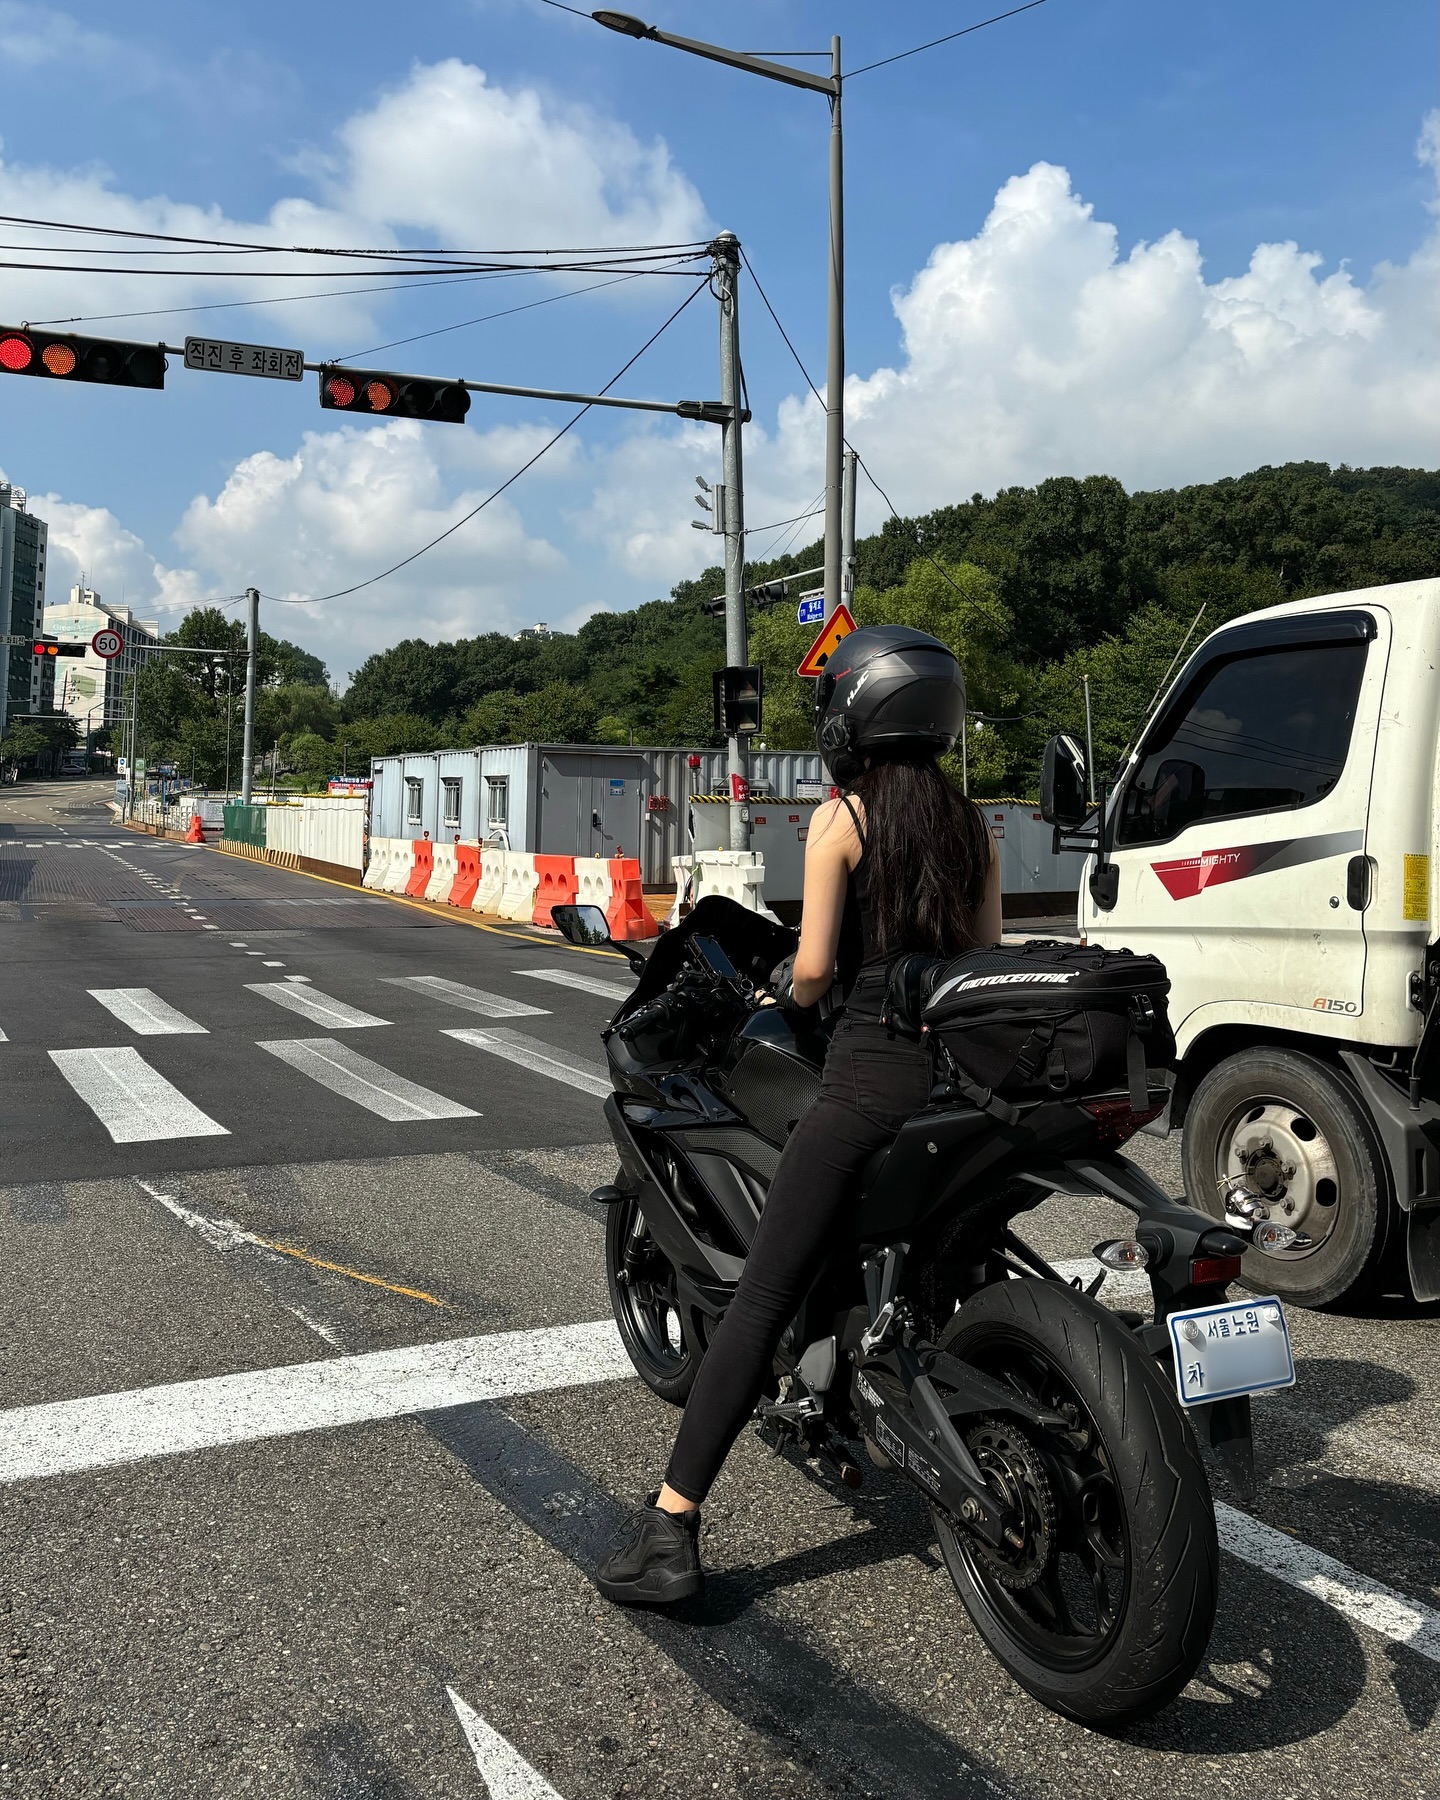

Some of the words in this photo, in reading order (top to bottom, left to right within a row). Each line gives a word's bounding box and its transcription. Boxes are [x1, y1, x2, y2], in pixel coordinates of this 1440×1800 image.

[190, 342, 222, 368] 직진
[229, 346, 244, 370] 후
[251, 350, 299, 377] 좌회전
[99, 637, 117, 650] 50
[846, 669, 869, 707] HJC
[1200, 852, 1241, 867] MIGHTY
[957, 972, 1075, 992] MOTOCENTRIC
[1313, 998, 1357, 1013] A150
[1187, 1360, 1206, 1388] 차
